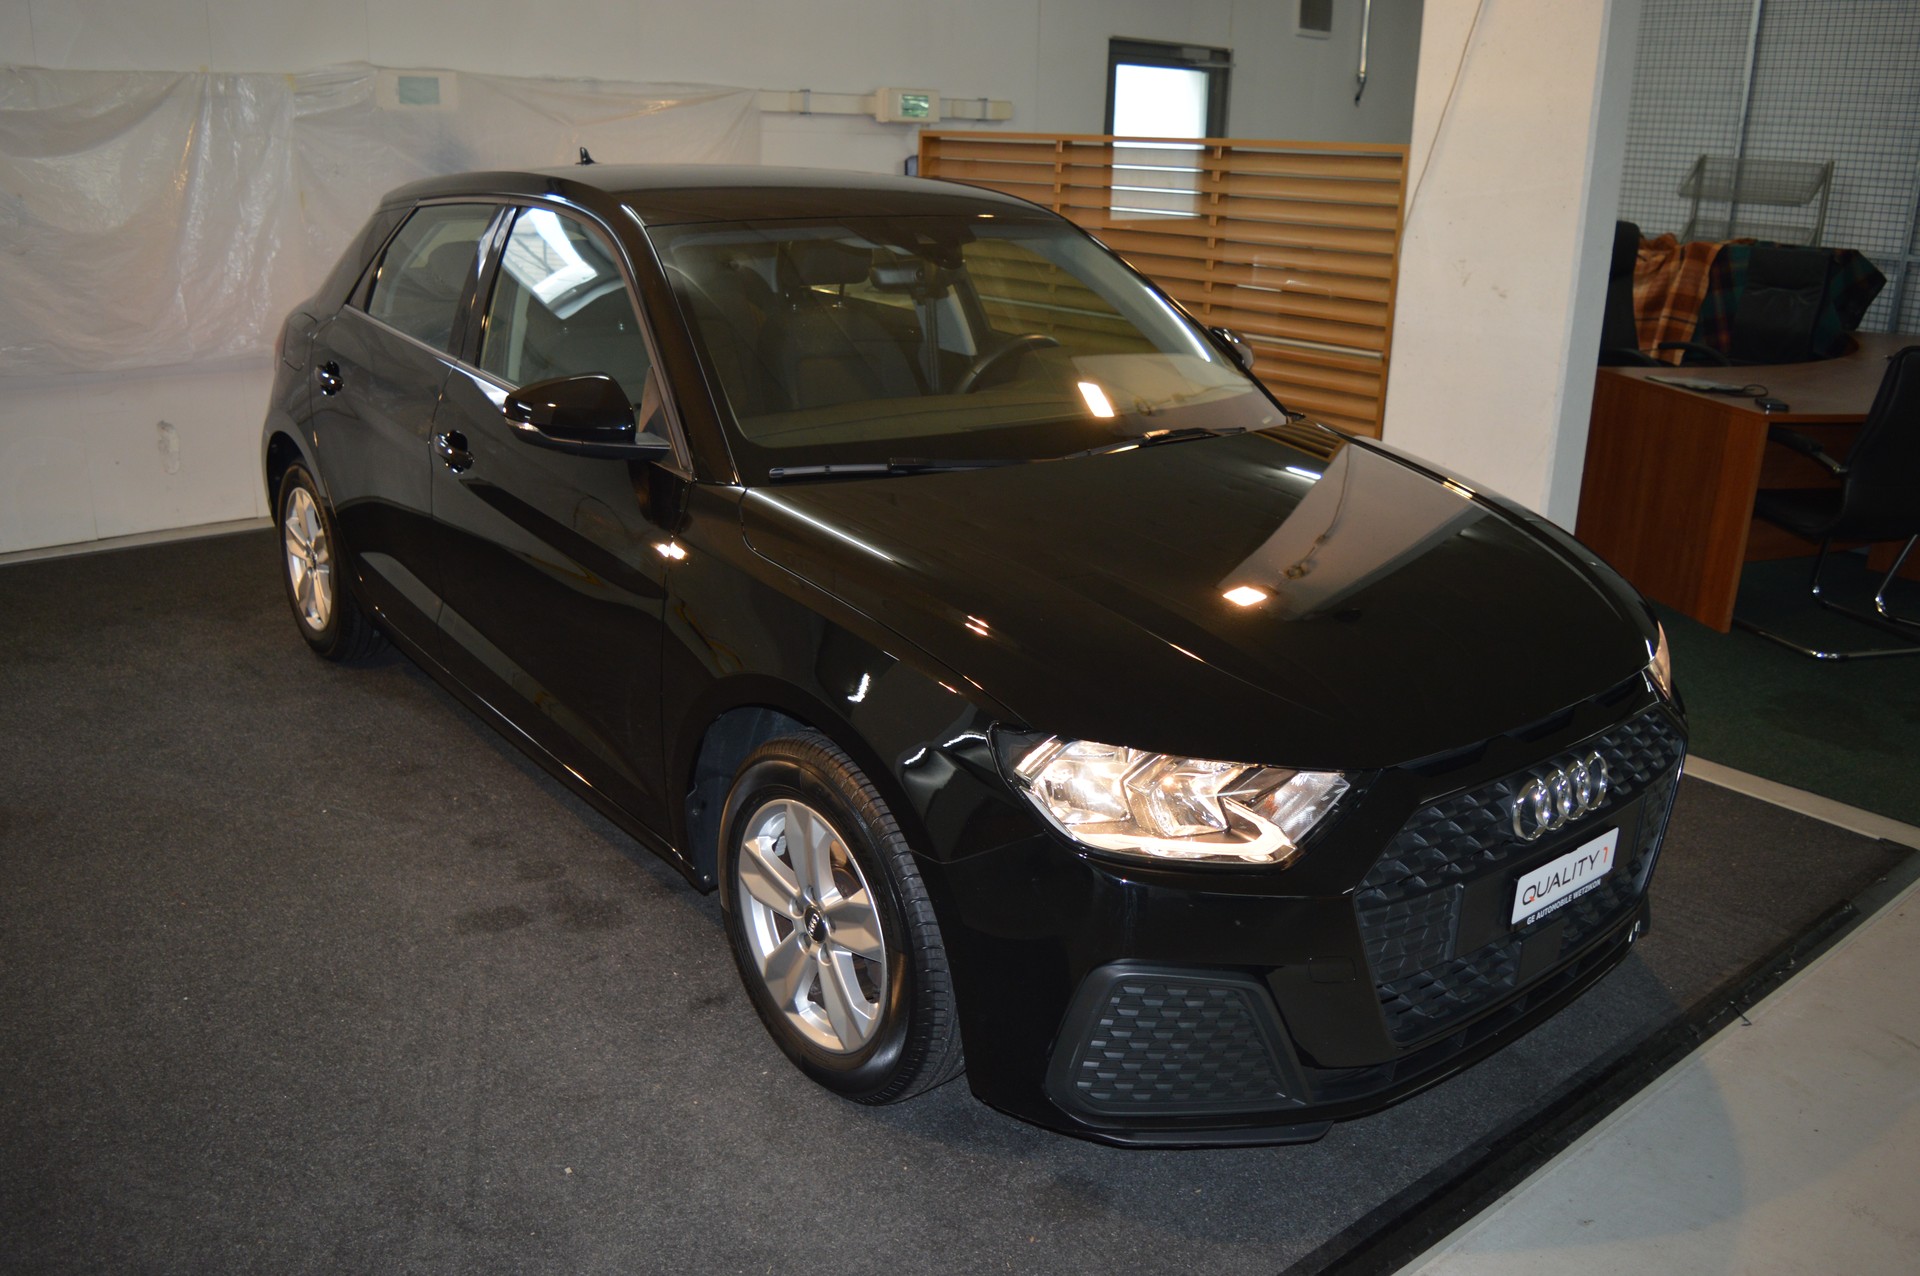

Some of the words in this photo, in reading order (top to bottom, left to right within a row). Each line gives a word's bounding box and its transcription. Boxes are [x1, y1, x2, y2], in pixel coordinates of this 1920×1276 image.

[1522, 850, 1600, 906] QUALITY
[1603, 847, 1608, 863] 1
[1526, 914, 1536, 925] GE
[1536, 894, 1573, 920] AUTOMOBILE
